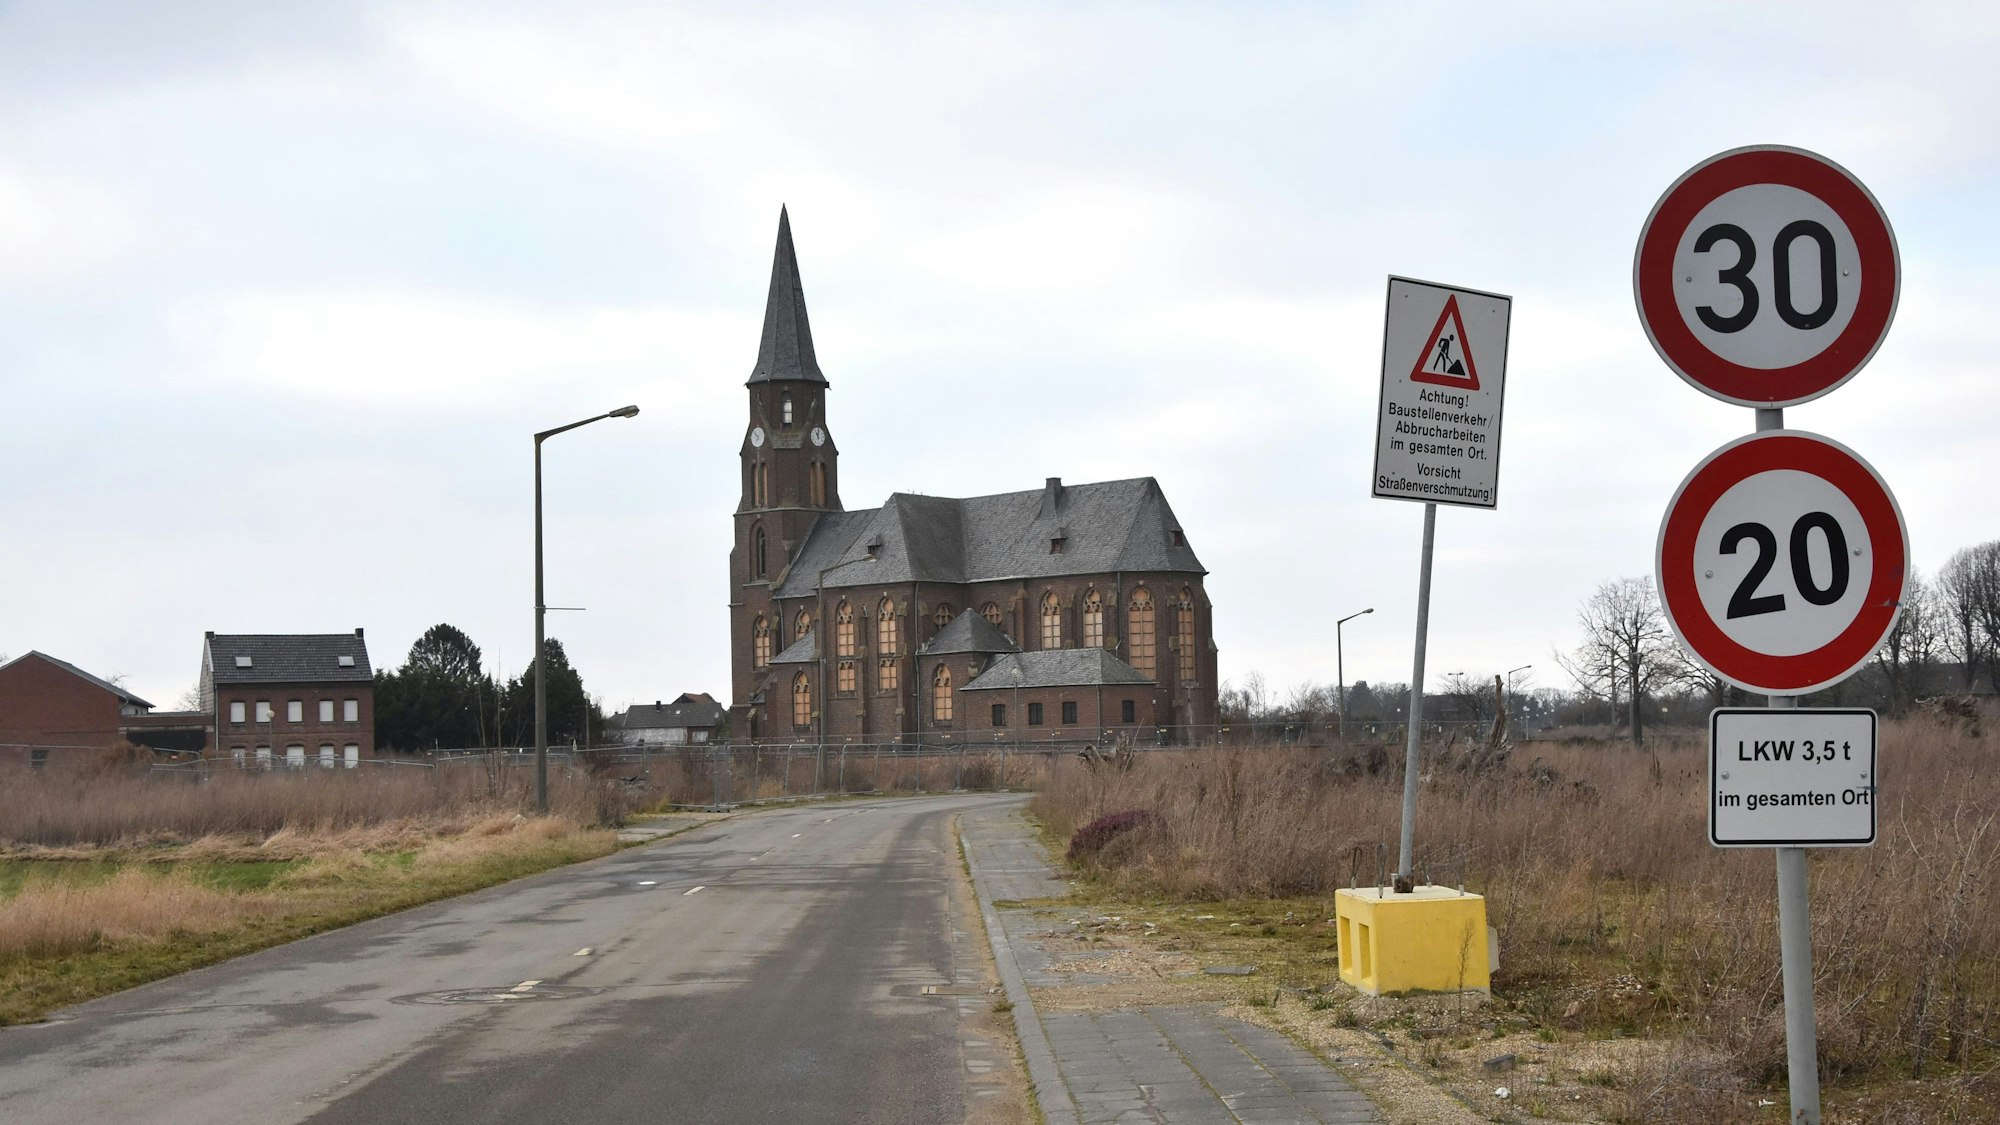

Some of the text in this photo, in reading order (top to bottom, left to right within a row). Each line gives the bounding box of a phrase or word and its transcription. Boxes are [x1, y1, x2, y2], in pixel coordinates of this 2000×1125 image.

[1694, 220, 1838, 333] 30
[1419, 388, 1469, 408] Achtung!
[1395, 421, 1485, 443] Abbrucharbeiten
[1390, 437, 1487, 460] im gesamten Ort.
[1417, 463, 1461, 479] Vorsicht
[1378, 476, 1493, 501] Straßenverschmutzung!
[1719, 511, 1850, 620] 20
[1738, 740, 1851, 764] LKW 3,5 t
[1719, 789, 1869, 810] im gesamten Ort
